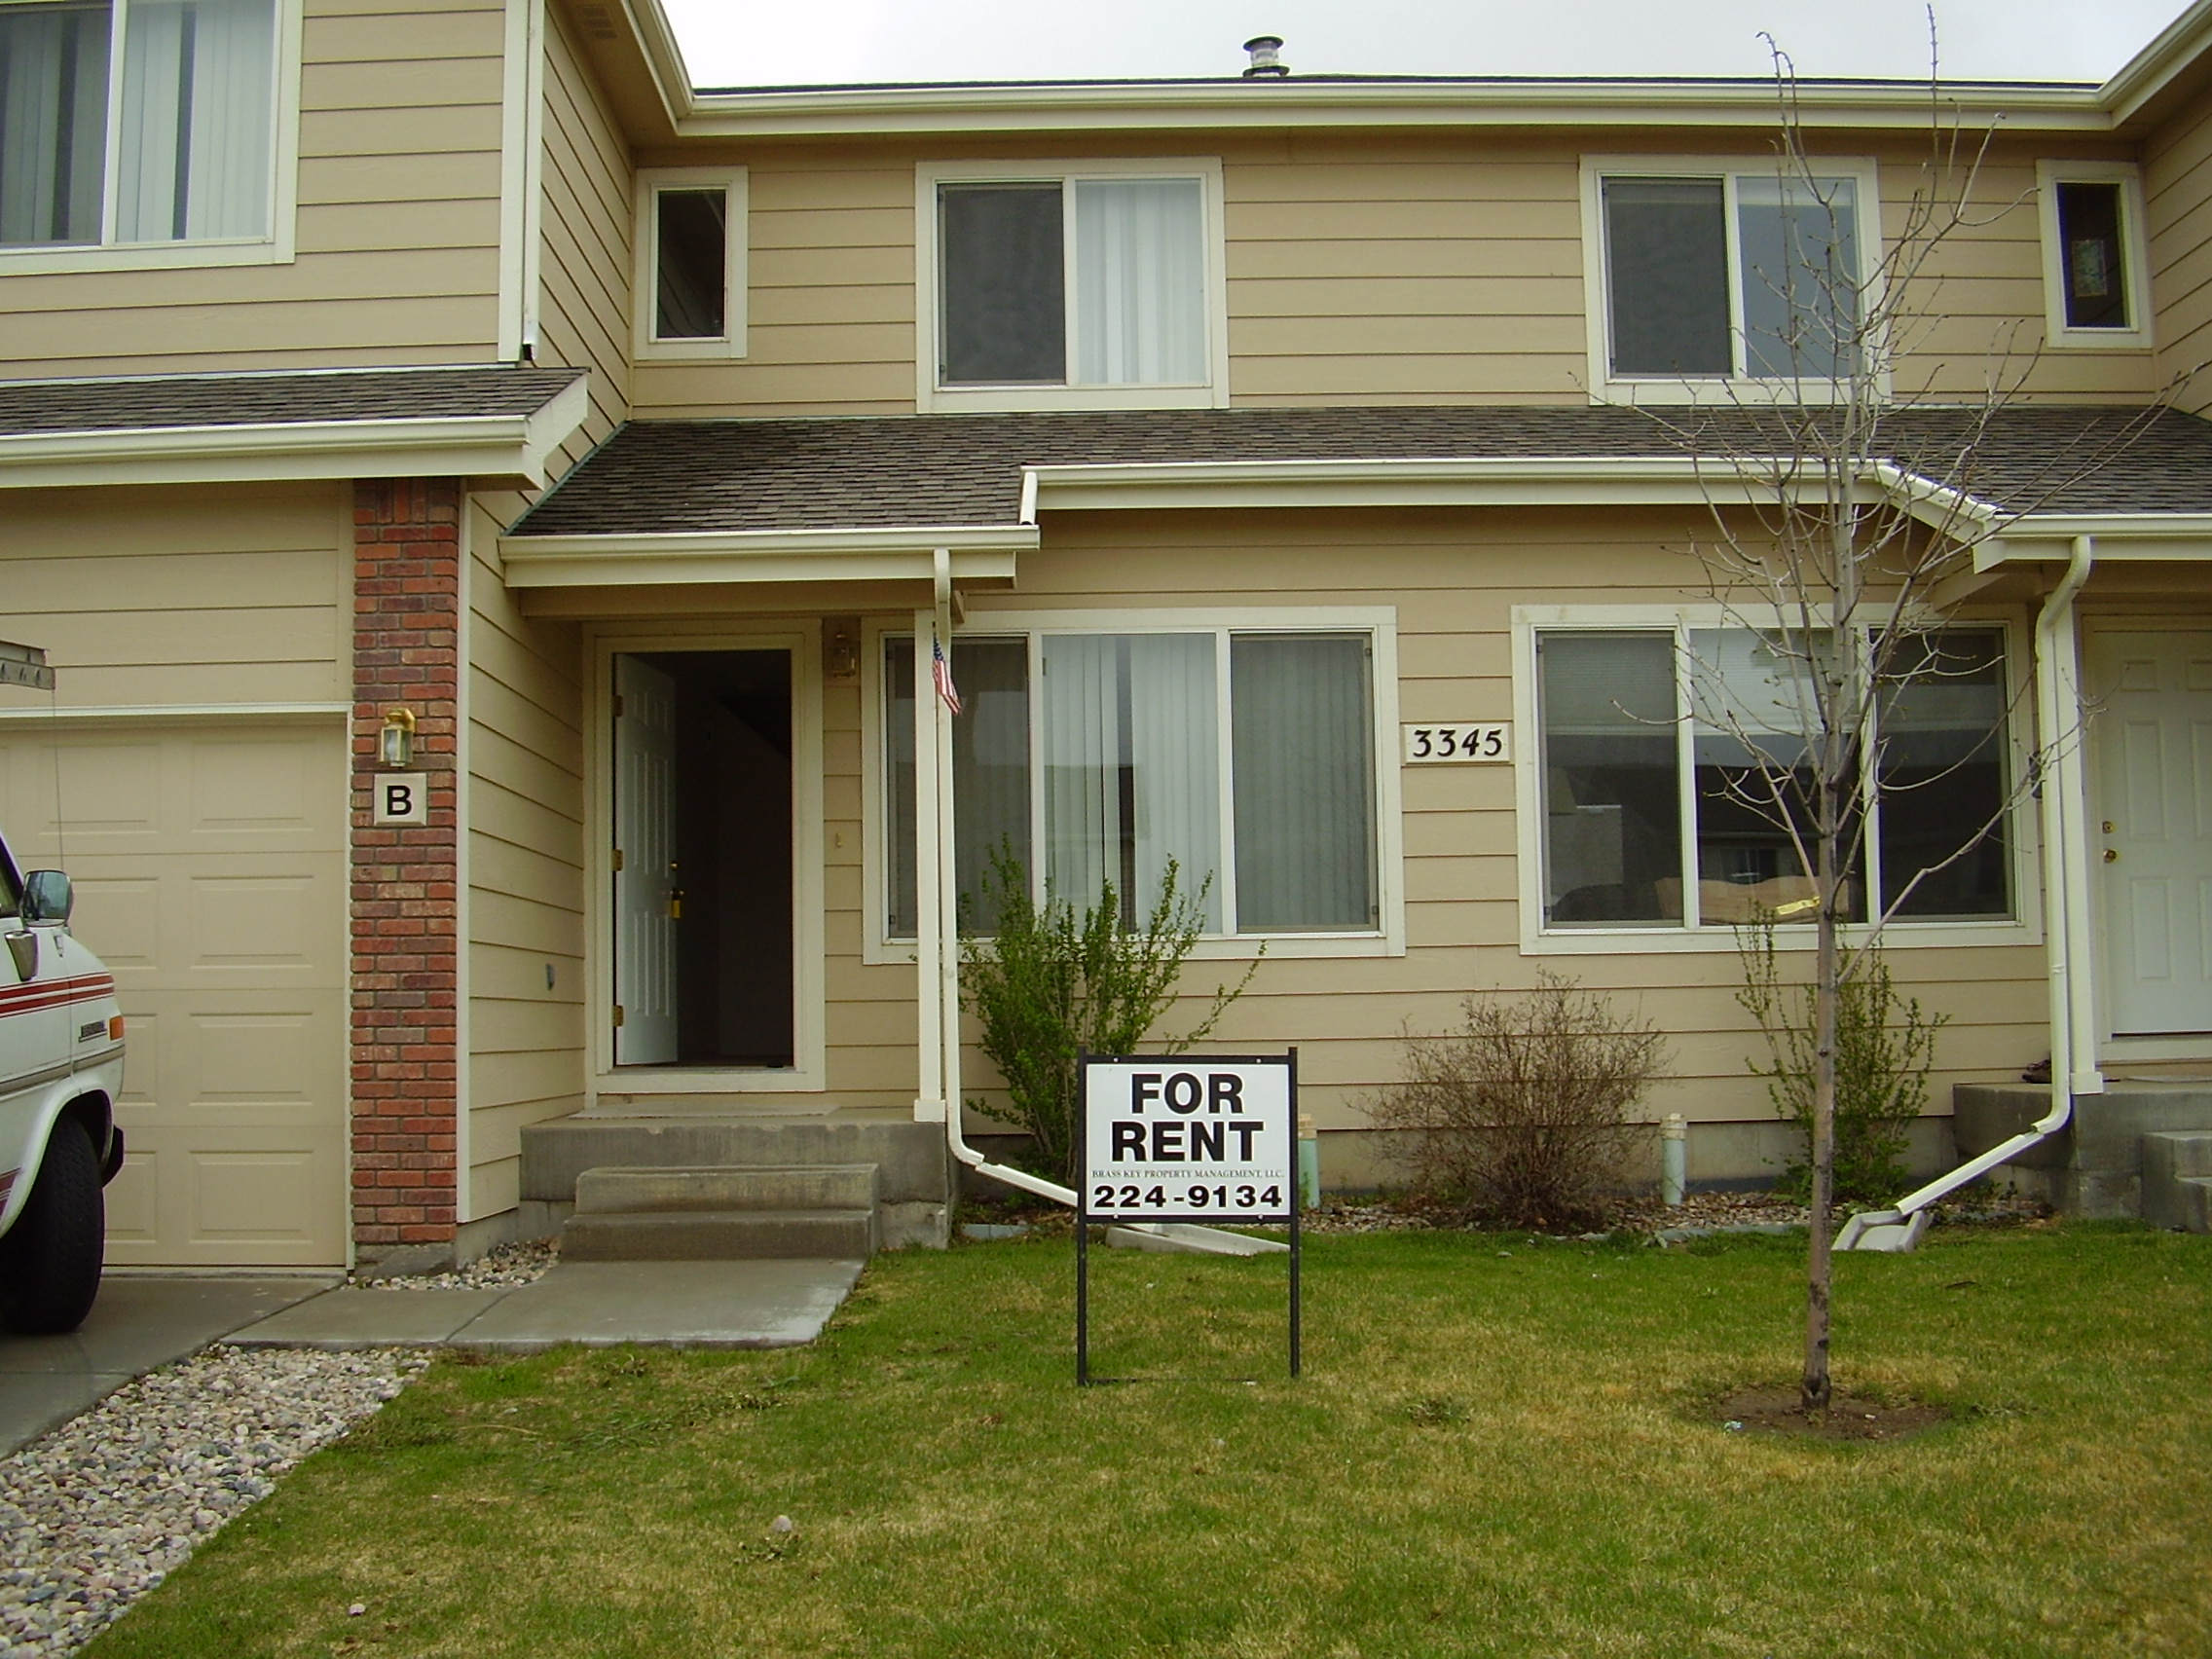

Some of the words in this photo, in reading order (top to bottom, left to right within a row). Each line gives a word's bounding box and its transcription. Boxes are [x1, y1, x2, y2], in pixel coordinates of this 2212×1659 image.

[1413, 727, 1502, 757] 3345
[387, 785, 413, 816] B
[1131, 1072, 1243, 1114] FOR
[1111, 1121, 1264, 1161] RENT
[1092, 1169, 1122, 1178] BRASS
[1123, 1169, 1142, 1178] KEY
[1144, 1169, 1191, 1178] PROPERTY
[1093, 1185, 1282, 1208] 224-9134
